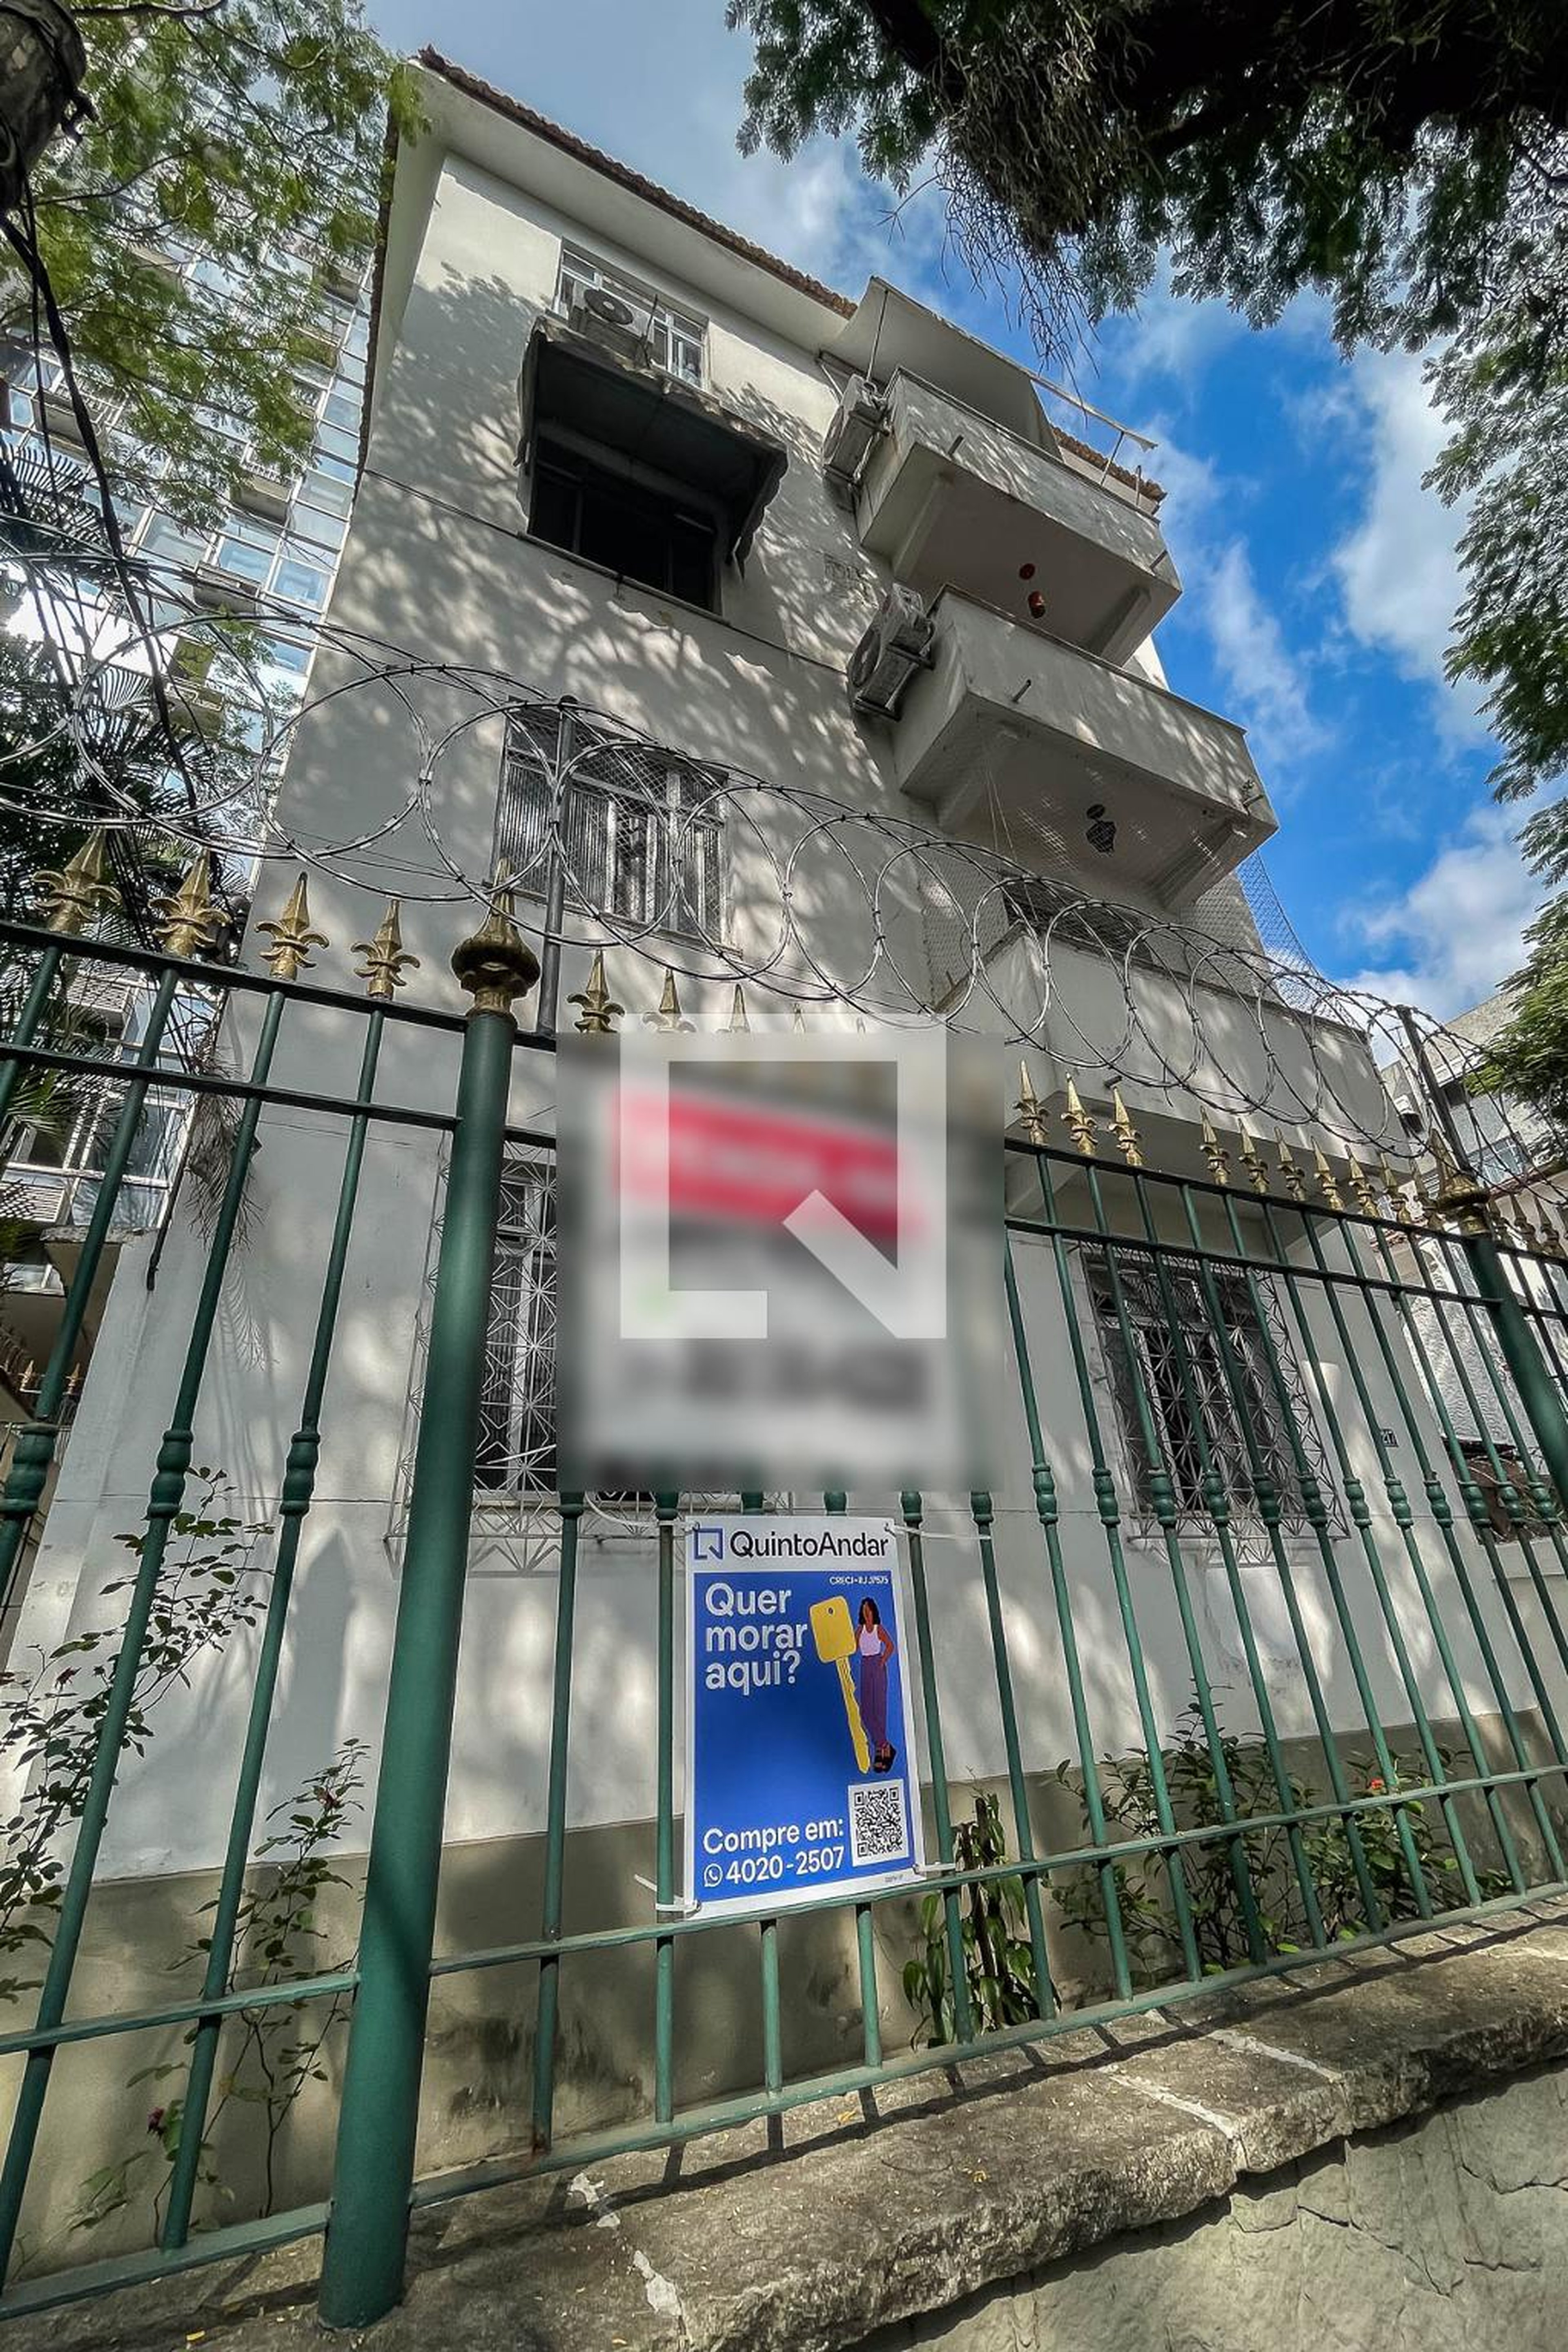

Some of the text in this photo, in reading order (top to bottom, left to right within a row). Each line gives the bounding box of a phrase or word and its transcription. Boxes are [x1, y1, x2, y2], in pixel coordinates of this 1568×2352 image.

[730, 1530, 889, 1558] QuintoAndar
[706, 1583, 791, 1616] Quer
[706, 1624, 808, 1651] morar
[706, 1650, 800, 1695] aqui?
[703, 1818, 844, 1854] Compre em:
